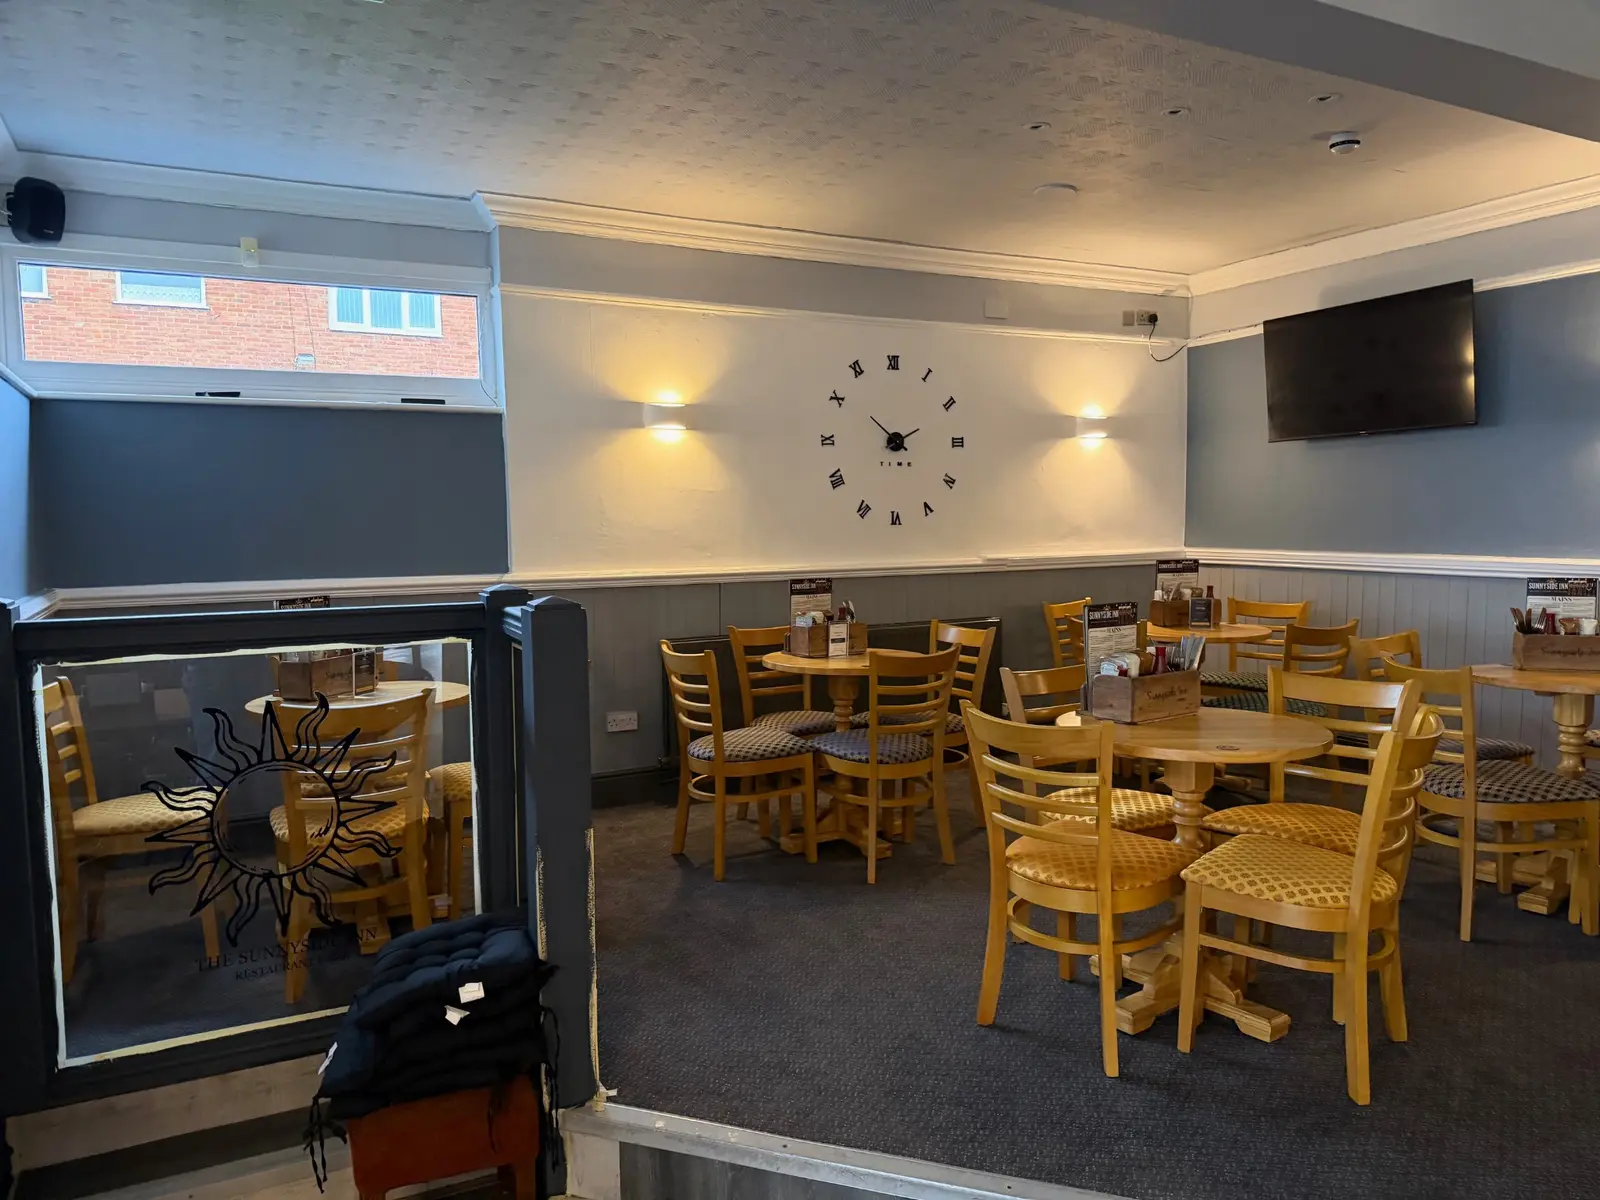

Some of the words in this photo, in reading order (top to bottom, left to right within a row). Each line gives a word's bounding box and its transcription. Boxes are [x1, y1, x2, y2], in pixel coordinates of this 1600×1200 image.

[848, 359, 865, 378] XI
[887, 355, 900, 370] XII
[828, 389, 846, 408] X
[942, 396, 956, 412] II
[821, 434, 835, 447] IX
[951, 436, 964, 448] III
[828, 468, 845, 490] VIII
[942, 473, 956, 489] IV
[856, 499, 872, 519] VII
[890, 511, 902, 525] VI
[1528, 582, 1558, 590] SUNNYSIDE
[1559, 582, 1568, 590] INN
[195, 954, 234, 972] THE
